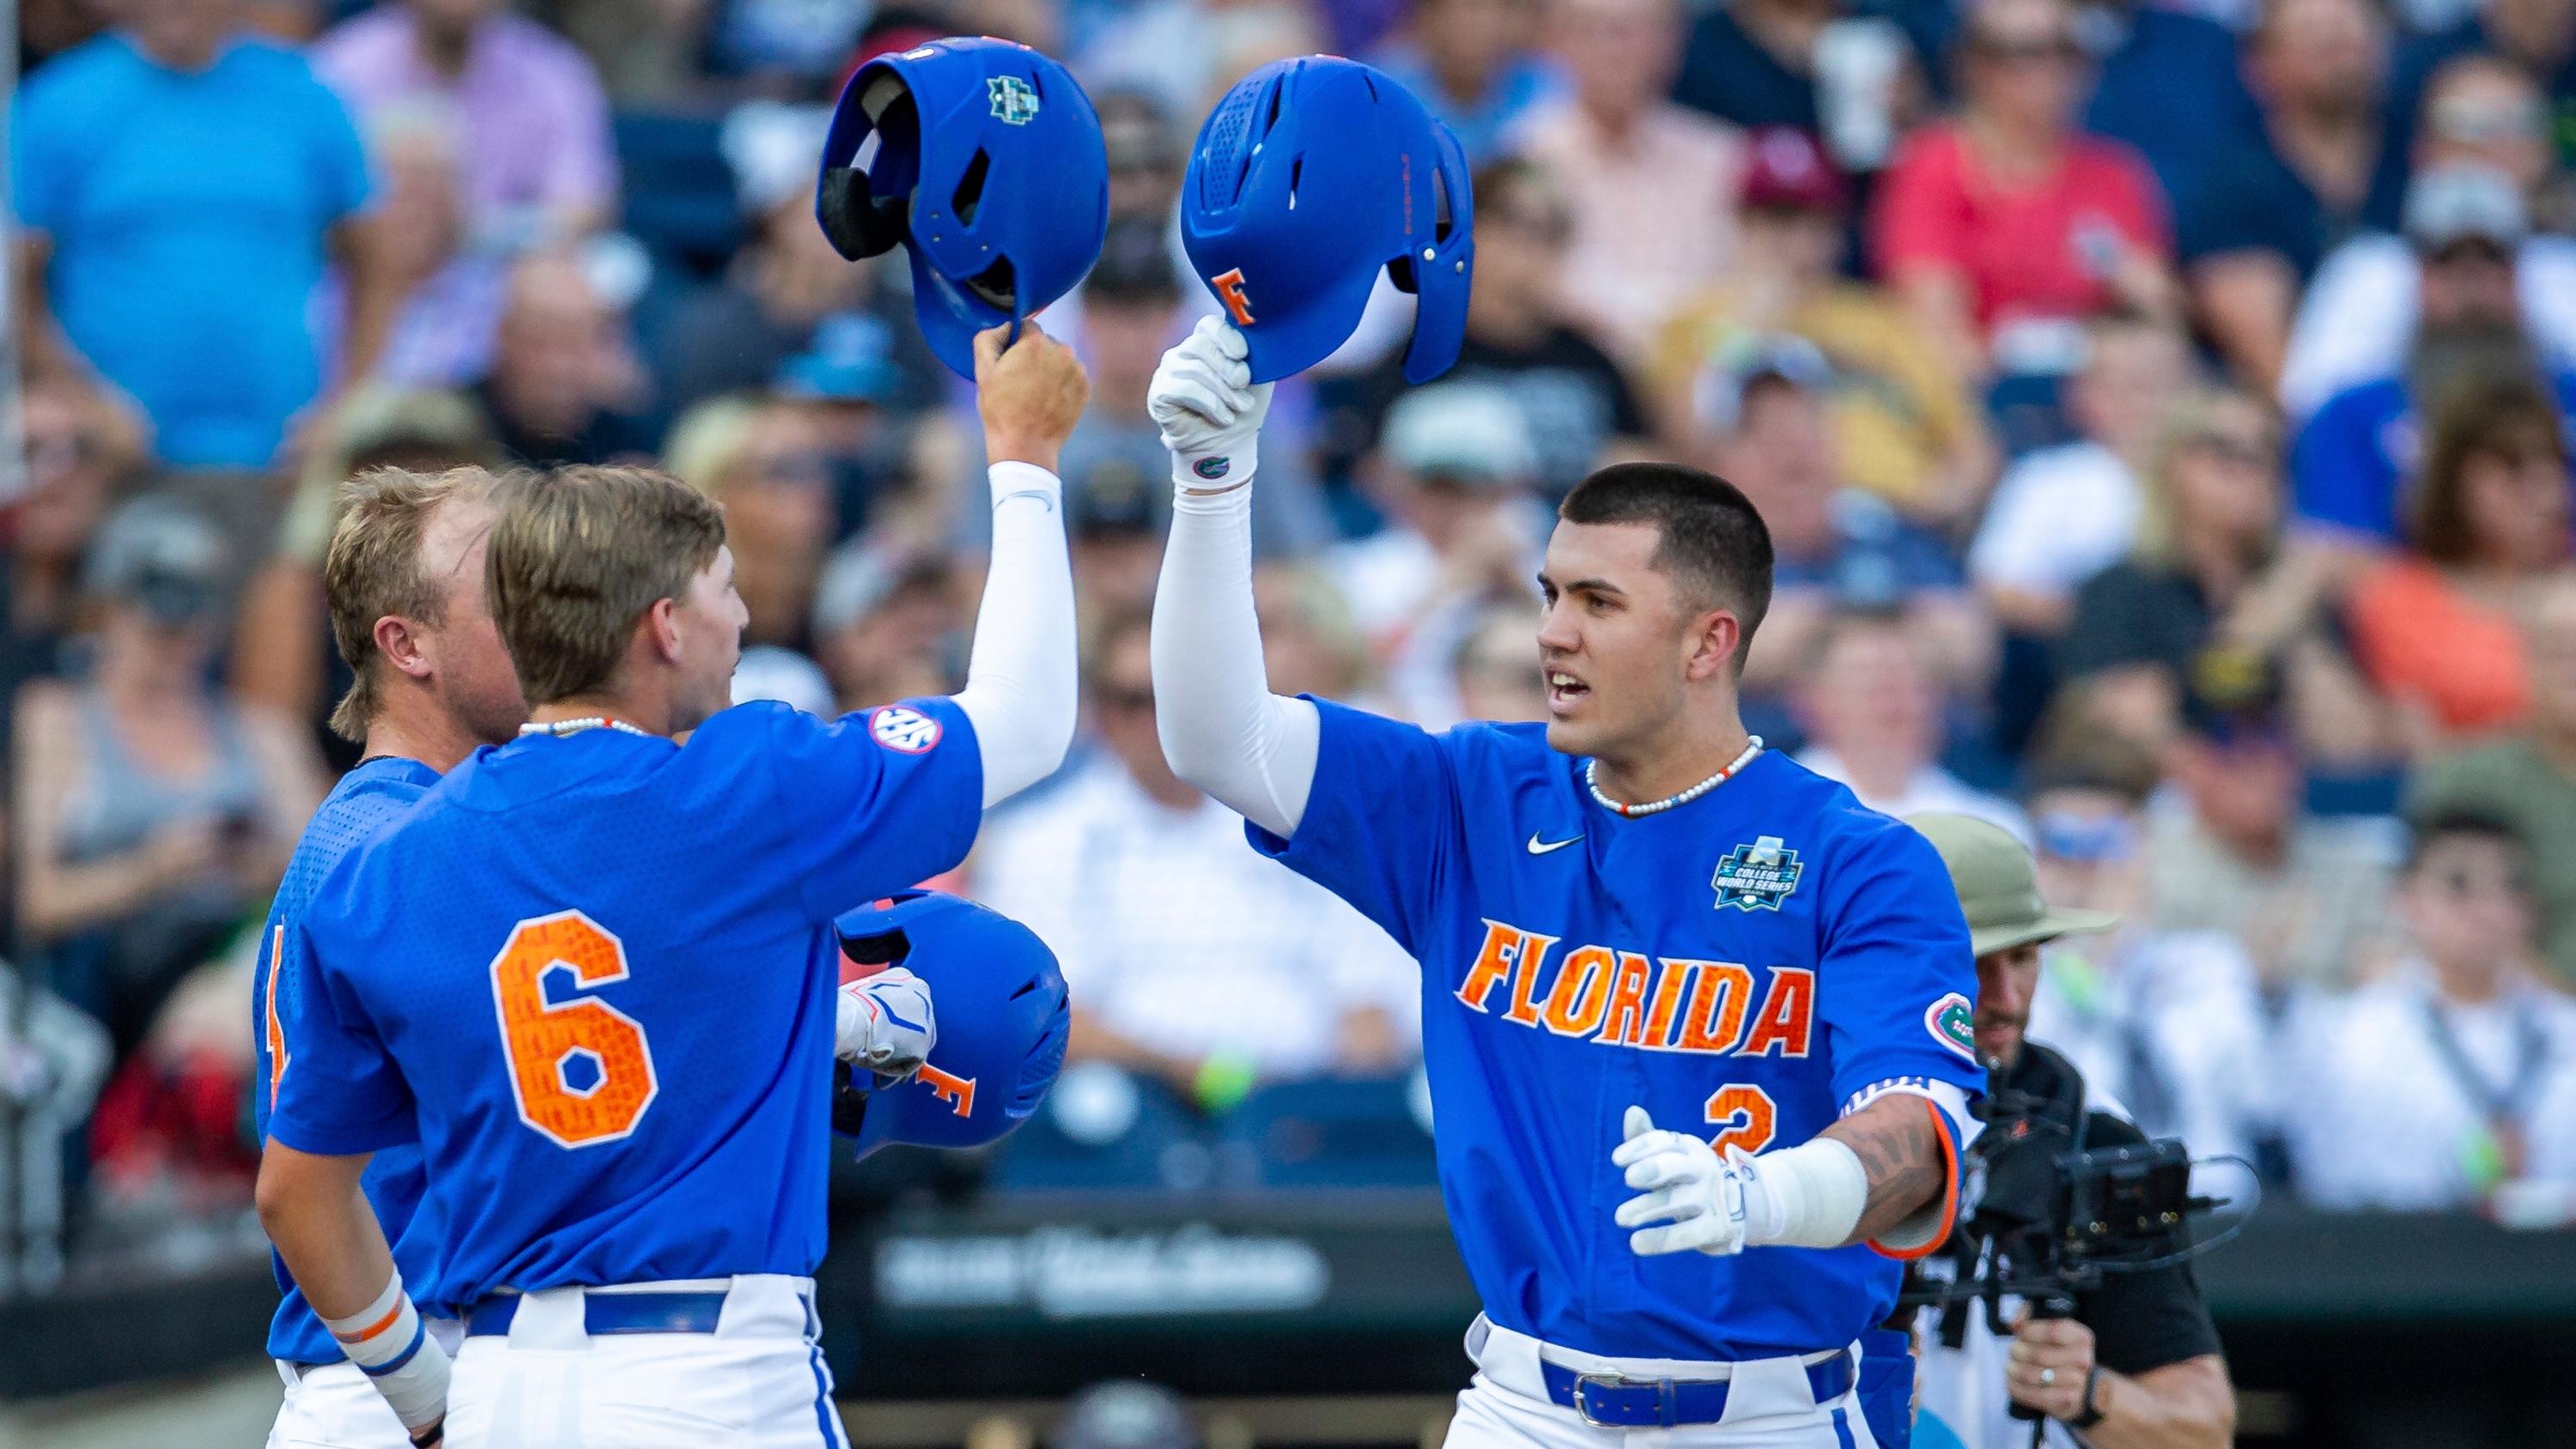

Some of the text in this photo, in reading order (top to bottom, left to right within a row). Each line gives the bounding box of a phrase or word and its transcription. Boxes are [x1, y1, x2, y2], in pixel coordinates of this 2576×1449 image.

[1211, 267, 1256, 325] F
[1716, 876, 1793, 892] WORLD SERIES
[1735, 867, 1782, 881] COLLEGE
[1454, 918, 1815, 1058] FLORIDA
[490, 908, 659, 1150] 6
[915, 1062, 975, 1119] F
[1704, 1083, 1776, 1162] 2
